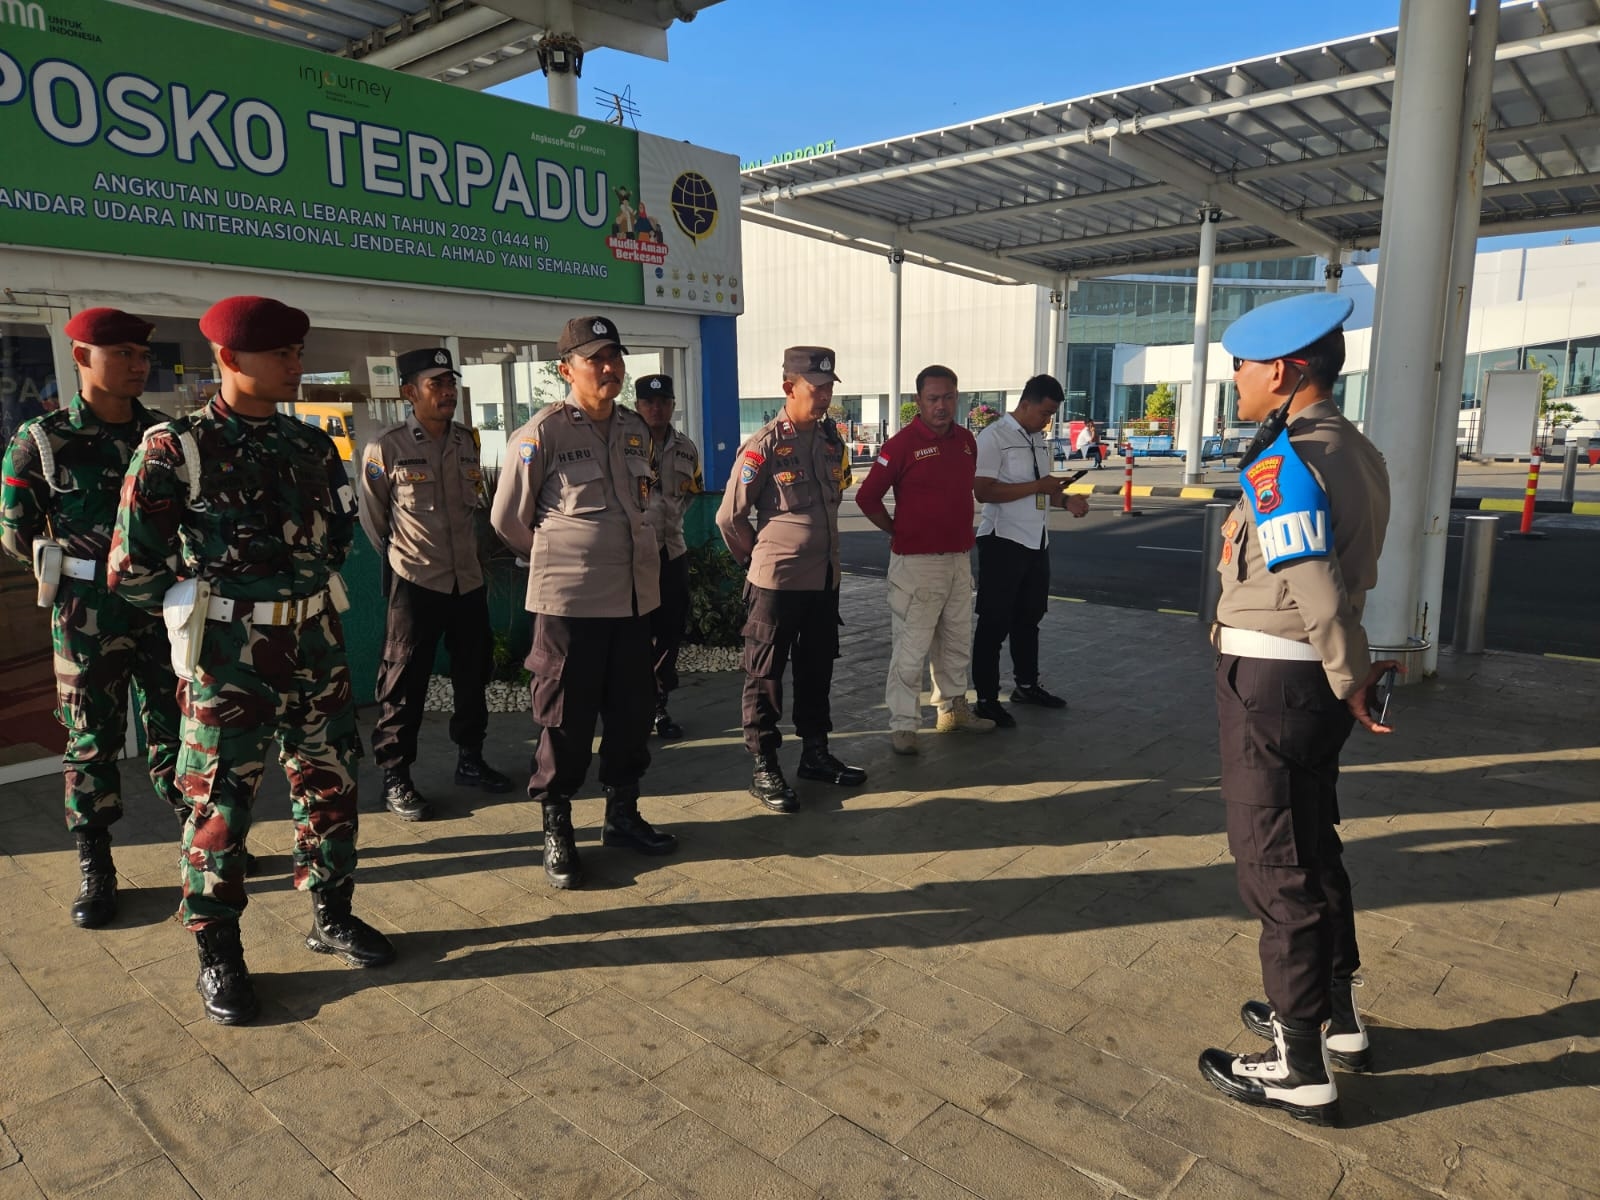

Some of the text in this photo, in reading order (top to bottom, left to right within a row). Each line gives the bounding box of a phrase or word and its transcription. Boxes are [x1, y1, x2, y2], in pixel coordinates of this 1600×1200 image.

[48, 16, 83, 29] UNTUK
[49, 25, 103, 42] INDONESIA
[772, 139, 835, 165] AIRPORT
[308, 111, 608, 228] TERPADU
[93, 172, 549, 252] ANGKUTAN UDARA LEBARAN TAHUN 2023 (1444 H)
[93, 199, 176, 227] UDARA
[182, 211, 344, 247] INTERNASIONAL
[350, 233, 436, 258] JENDERAL
[441, 245, 496, 264] AHMAD
[500, 252, 532, 269] YANI
[537, 257, 608, 278] SEMARANG
[609, 237, 668, 255] Mudik Aman
[559, 449, 591, 463] HERU
